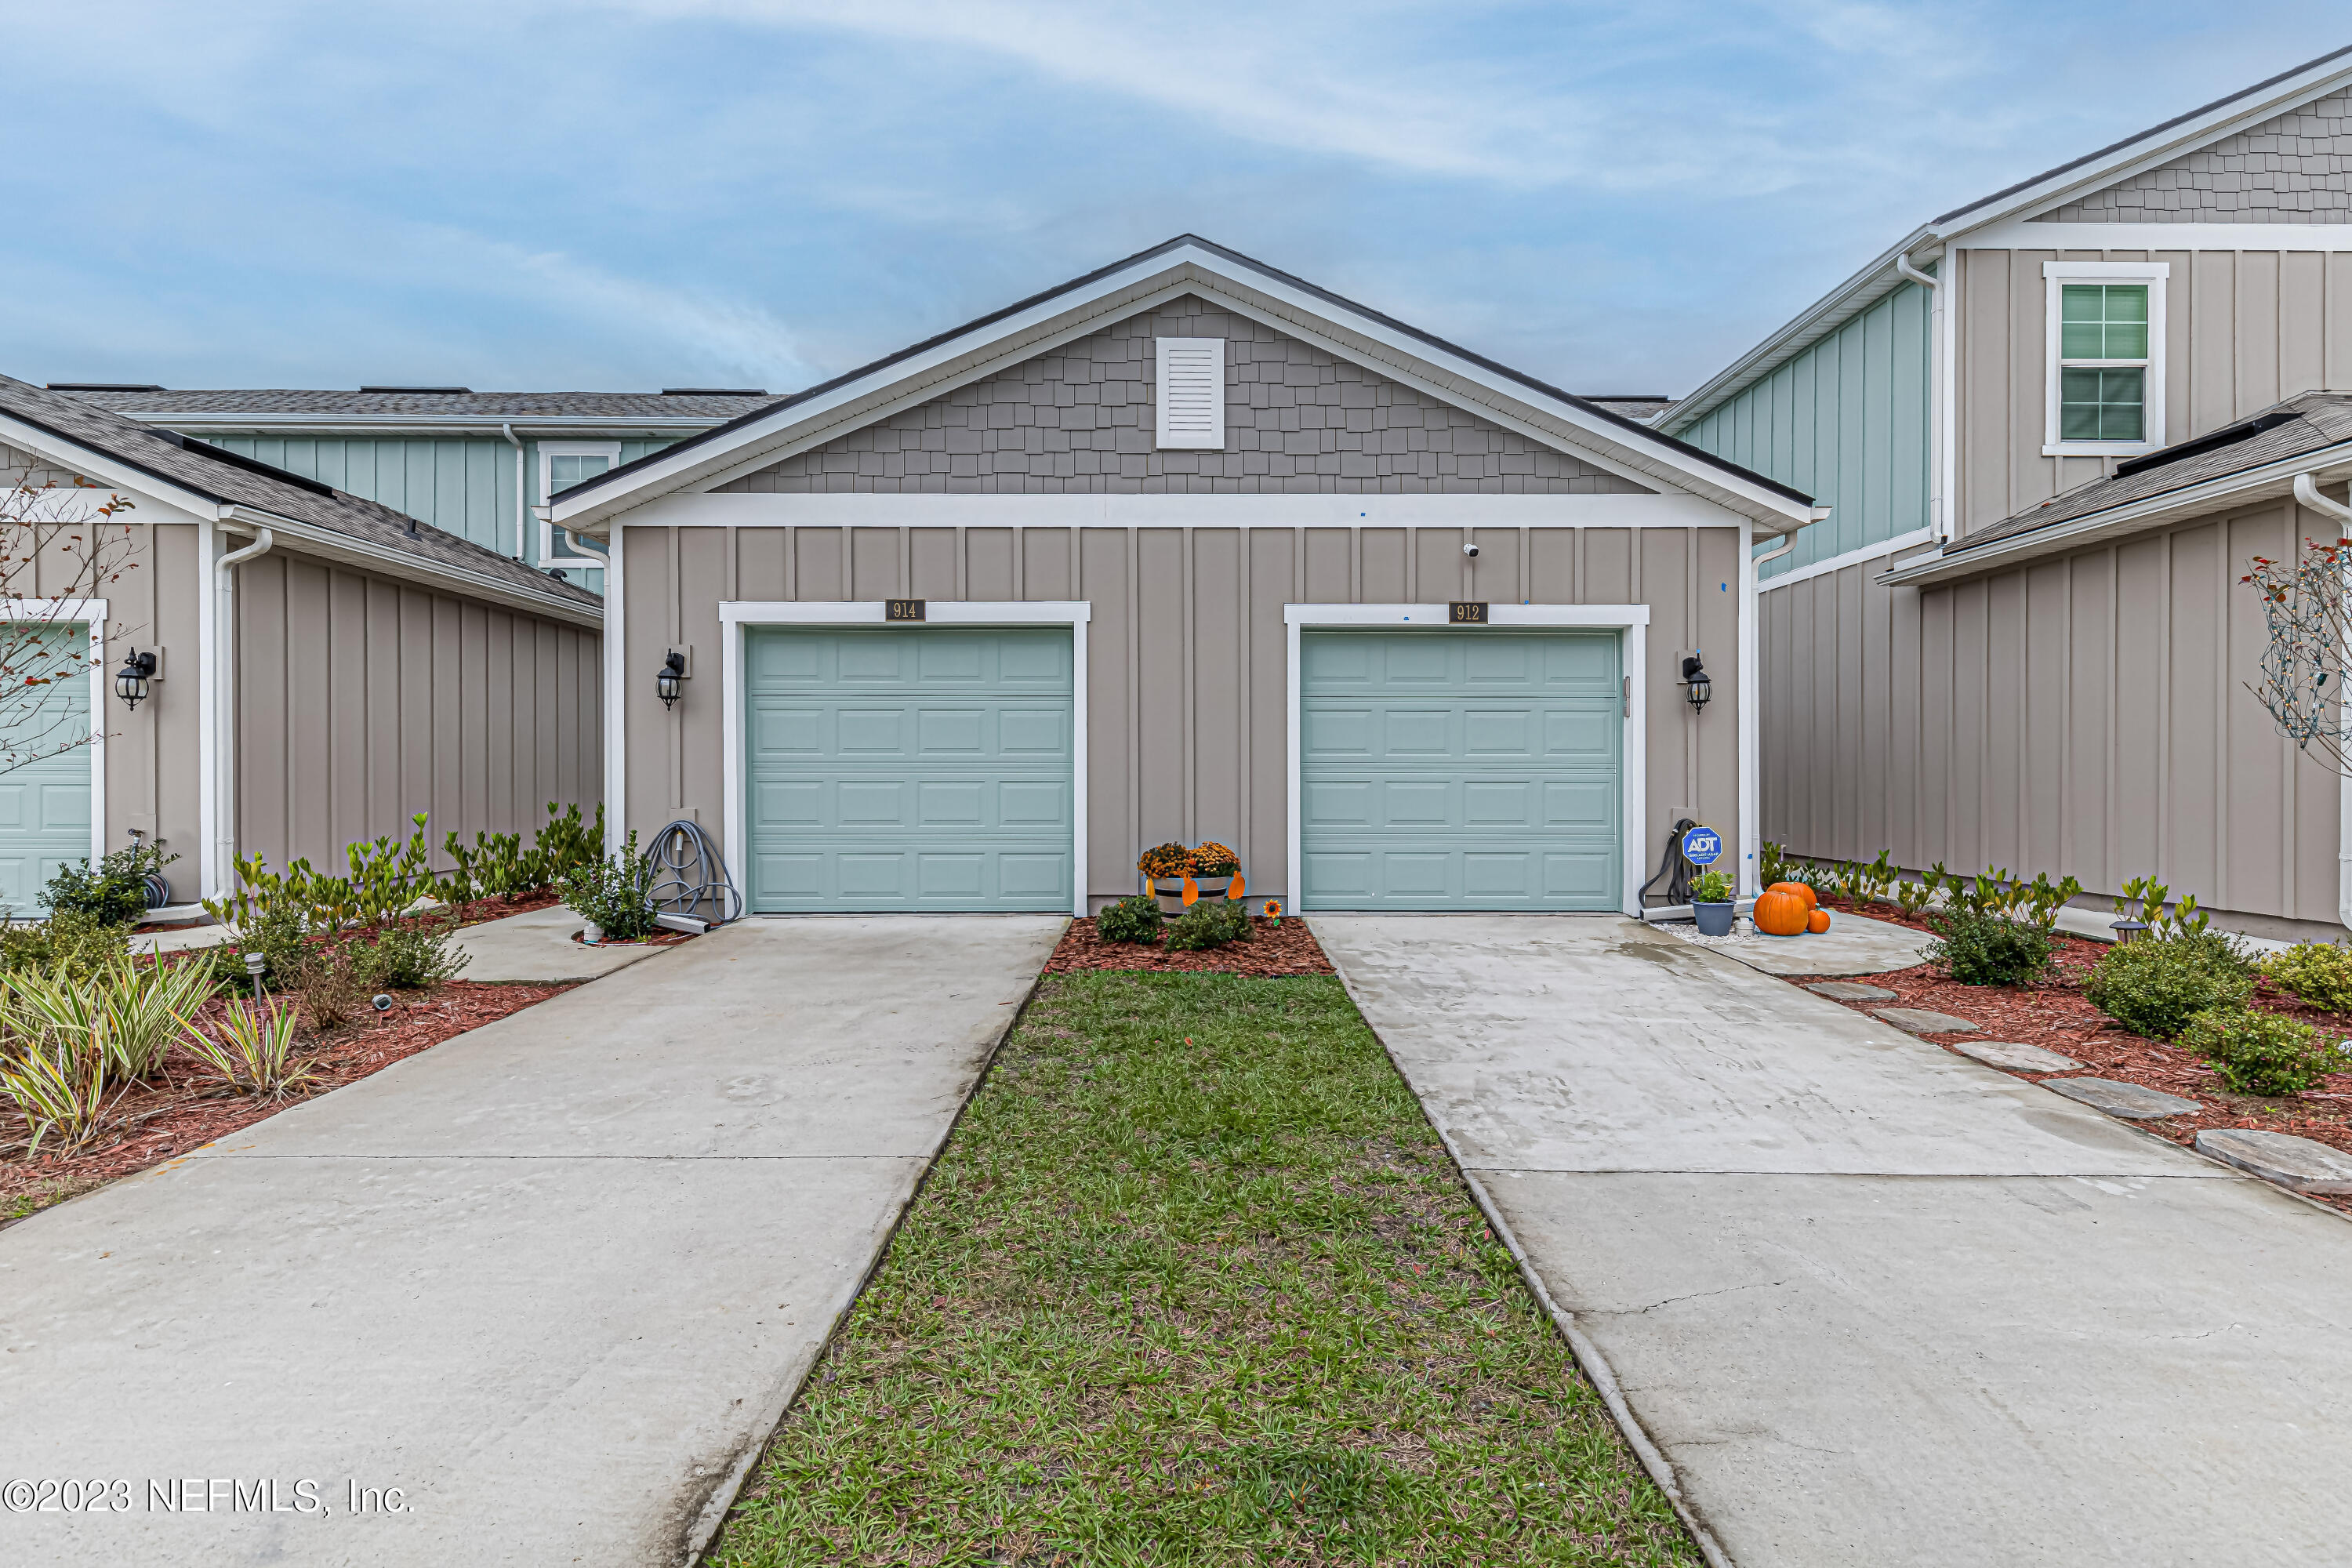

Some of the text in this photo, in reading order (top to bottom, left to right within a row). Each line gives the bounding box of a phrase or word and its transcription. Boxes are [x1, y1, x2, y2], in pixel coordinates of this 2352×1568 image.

[894, 602, 916, 618] 914
[1457, 604, 1479, 620] 912
[1687, 837, 1718, 853] ADT
